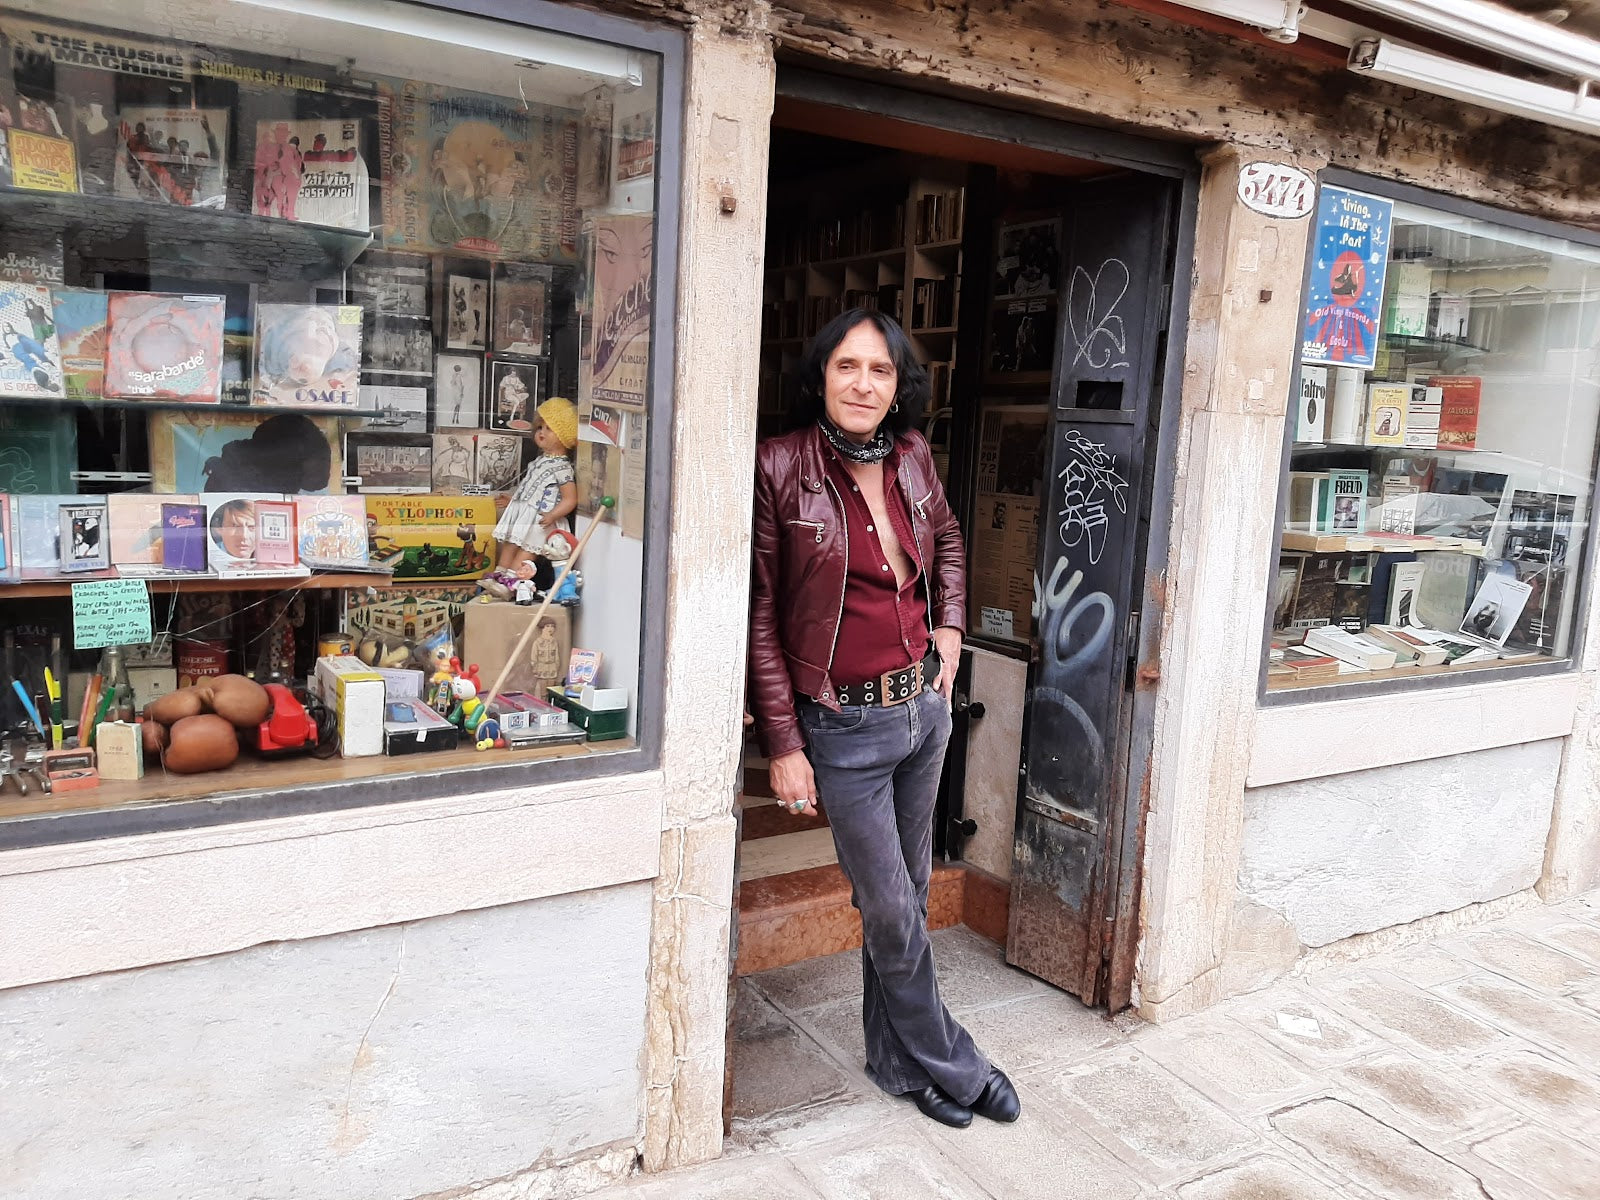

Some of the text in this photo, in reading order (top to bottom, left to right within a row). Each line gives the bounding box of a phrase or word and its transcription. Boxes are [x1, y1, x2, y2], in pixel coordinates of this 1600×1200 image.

[32, 31, 184, 66] THE MUSIC
[55, 49, 184, 79] MACHINE
[200, 60, 327, 93] SHADOWS OF KNIGHT
[1245, 170, 1307, 210] 3474
[295, 388, 353, 404] OSAGE
[980, 463, 997, 474] 72
[1335, 480, 1363, 494] FREUD
[386, 508, 474, 519] XYLOPHONE
